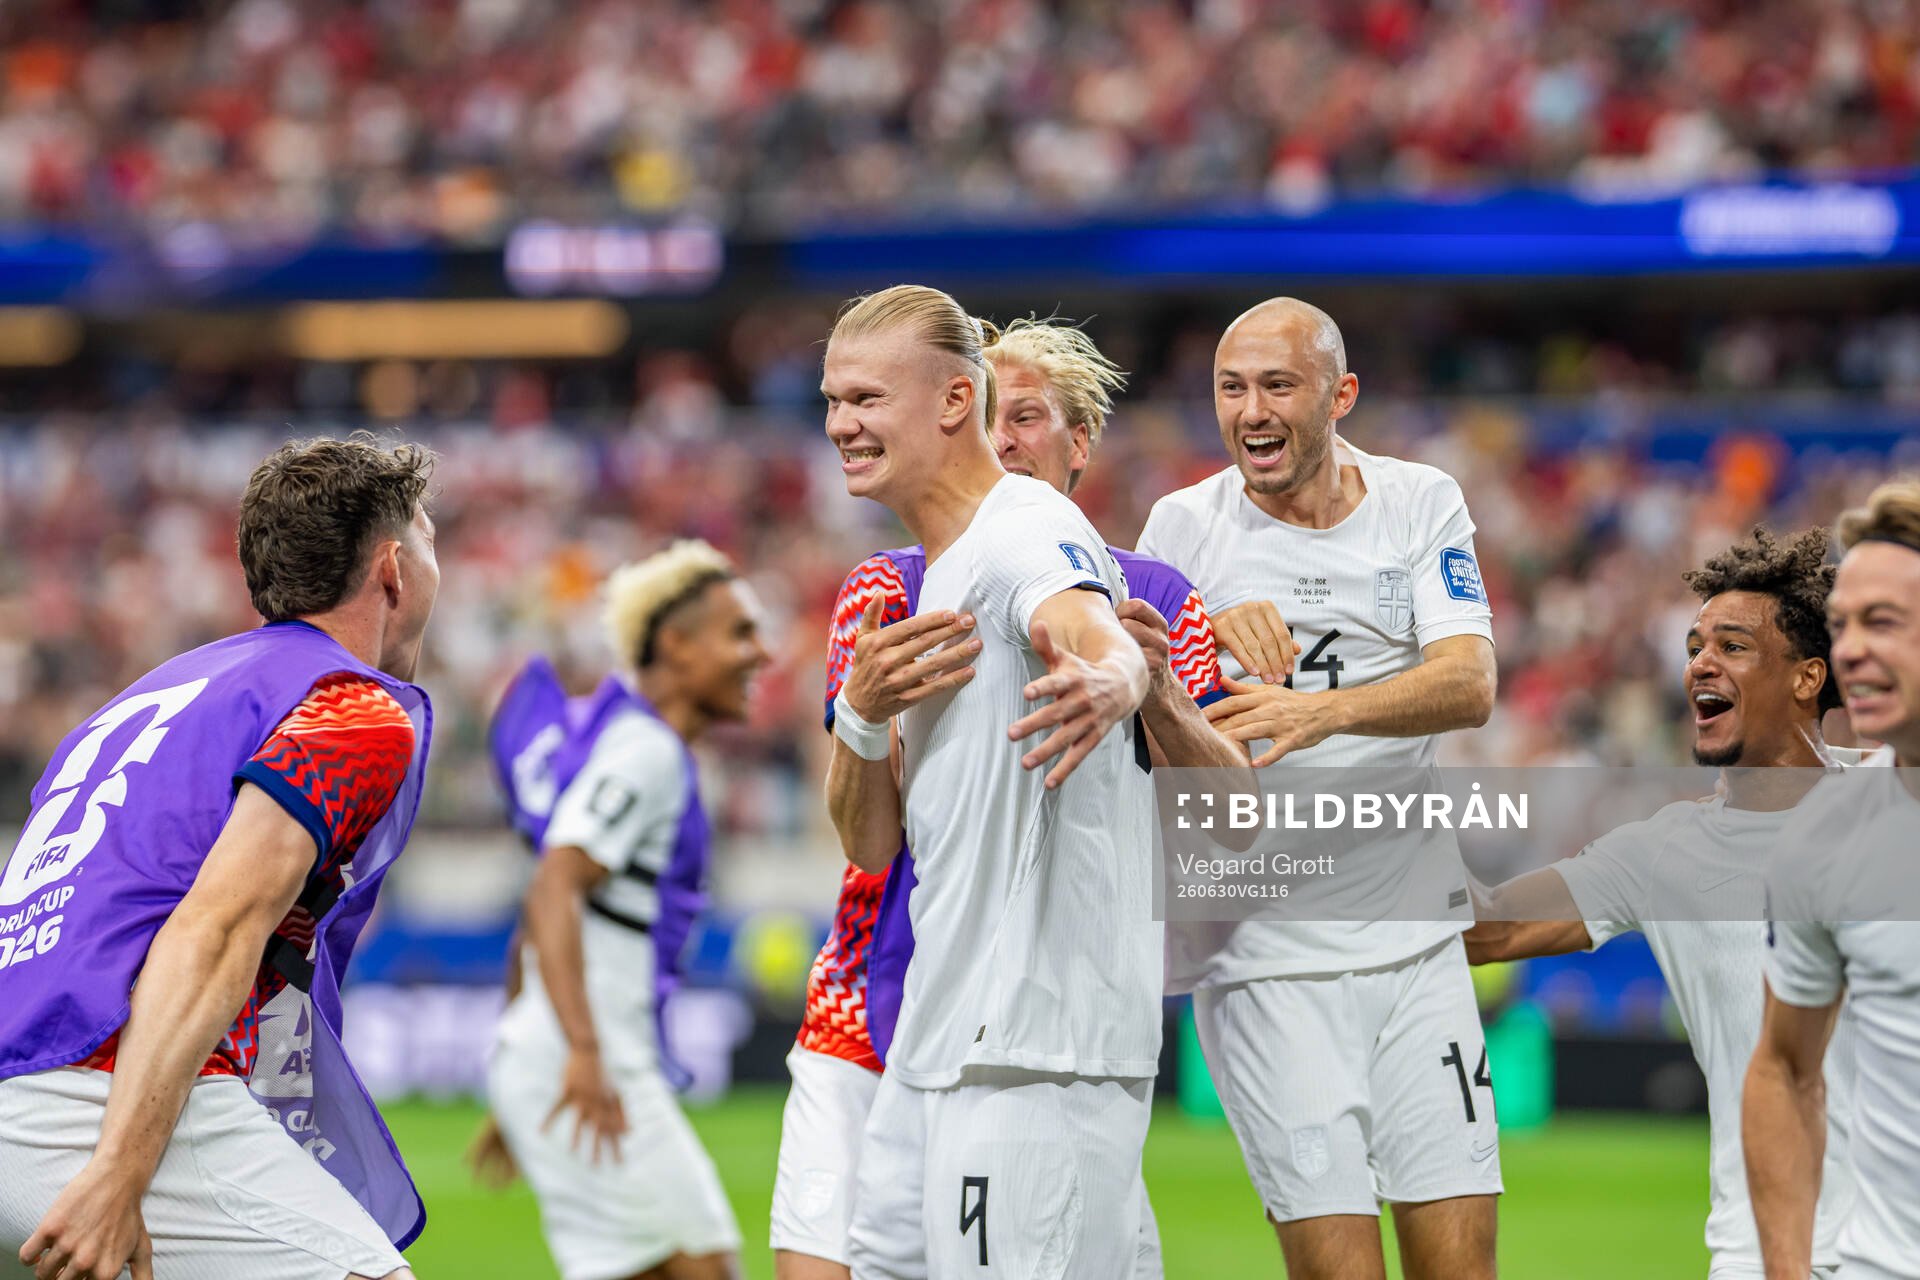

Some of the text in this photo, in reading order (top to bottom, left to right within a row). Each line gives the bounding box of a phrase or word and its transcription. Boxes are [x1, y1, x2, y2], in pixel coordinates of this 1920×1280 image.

[24, 843, 71, 880] FIFA
[0, 885, 75, 935] RLD CUP
[0, 914, 64, 970] 026
[960, 1176, 989, 1266] 9
